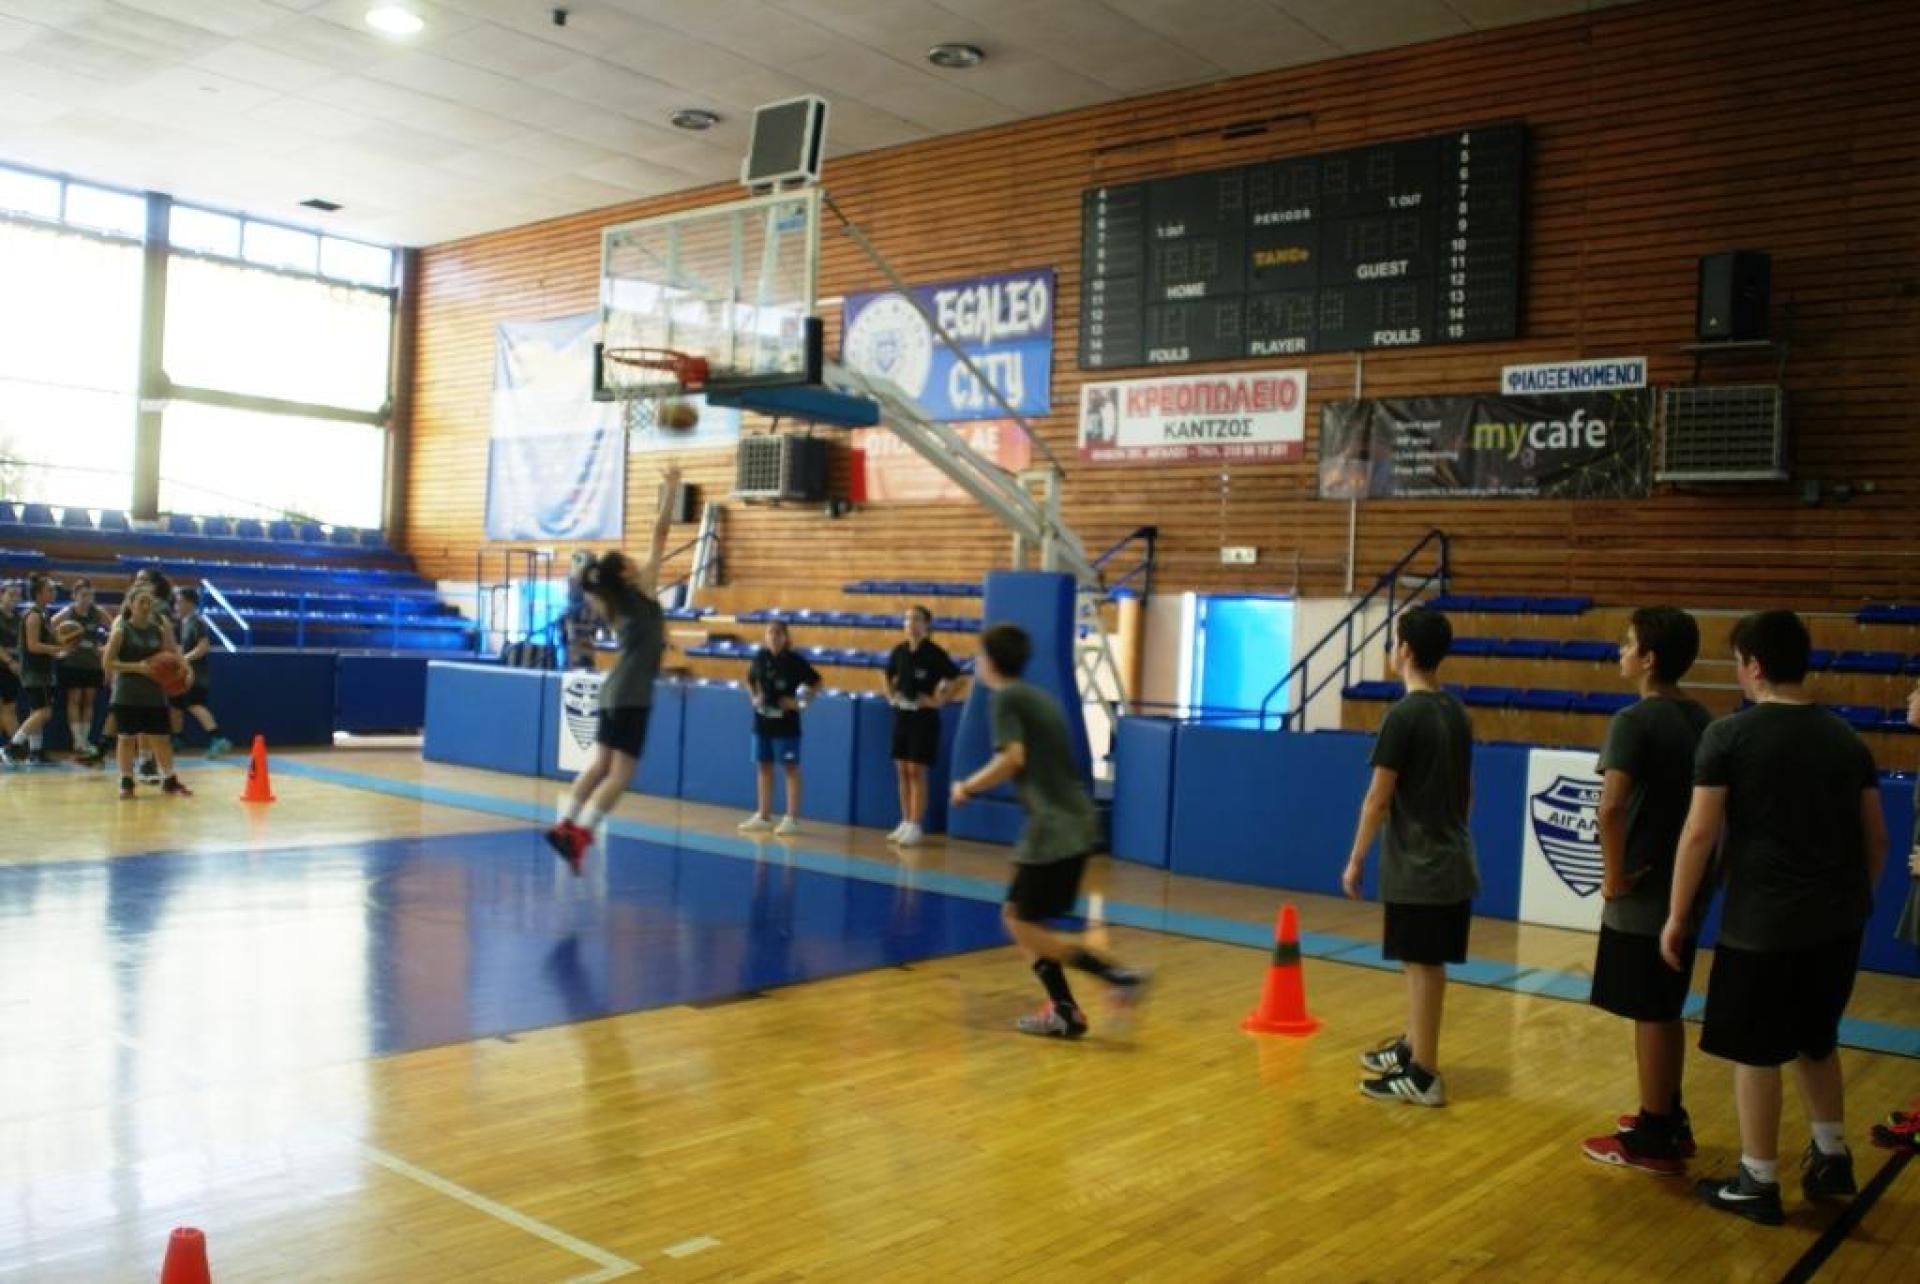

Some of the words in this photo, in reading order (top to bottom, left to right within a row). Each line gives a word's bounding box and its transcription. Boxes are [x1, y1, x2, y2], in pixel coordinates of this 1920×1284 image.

[1460, 184, 1468, 197] 7
[1253, 208, 1311, 225] PERIODS
[1452, 239, 1467, 251] 10
[1356, 260, 1408, 279] GUEST
[1451, 255, 1465, 269] 11
[1450, 272, 1465, 285] 12
[1167, 282, 1206, 300] HOME
[1450, 289, 1464, 303] 13
[933, 278, 1048, 346] EGALEO
[1449, 307, 1464, 320] 14
[1373, 327, 1421, 345] FOULS
[1449, 324, 1464, 338] 15
[1149, 347, 1189, 362] FOULS
[1251, 337, 1306, 355] PLAYER
[948, 351, 1024, 410] CITY
[1126, 377, 1298, 417] ΚΡΕΟΠΩΛΕΙΟ
[1164, 417, 1253, 438] ΚΑΝΤΖΟΣ
